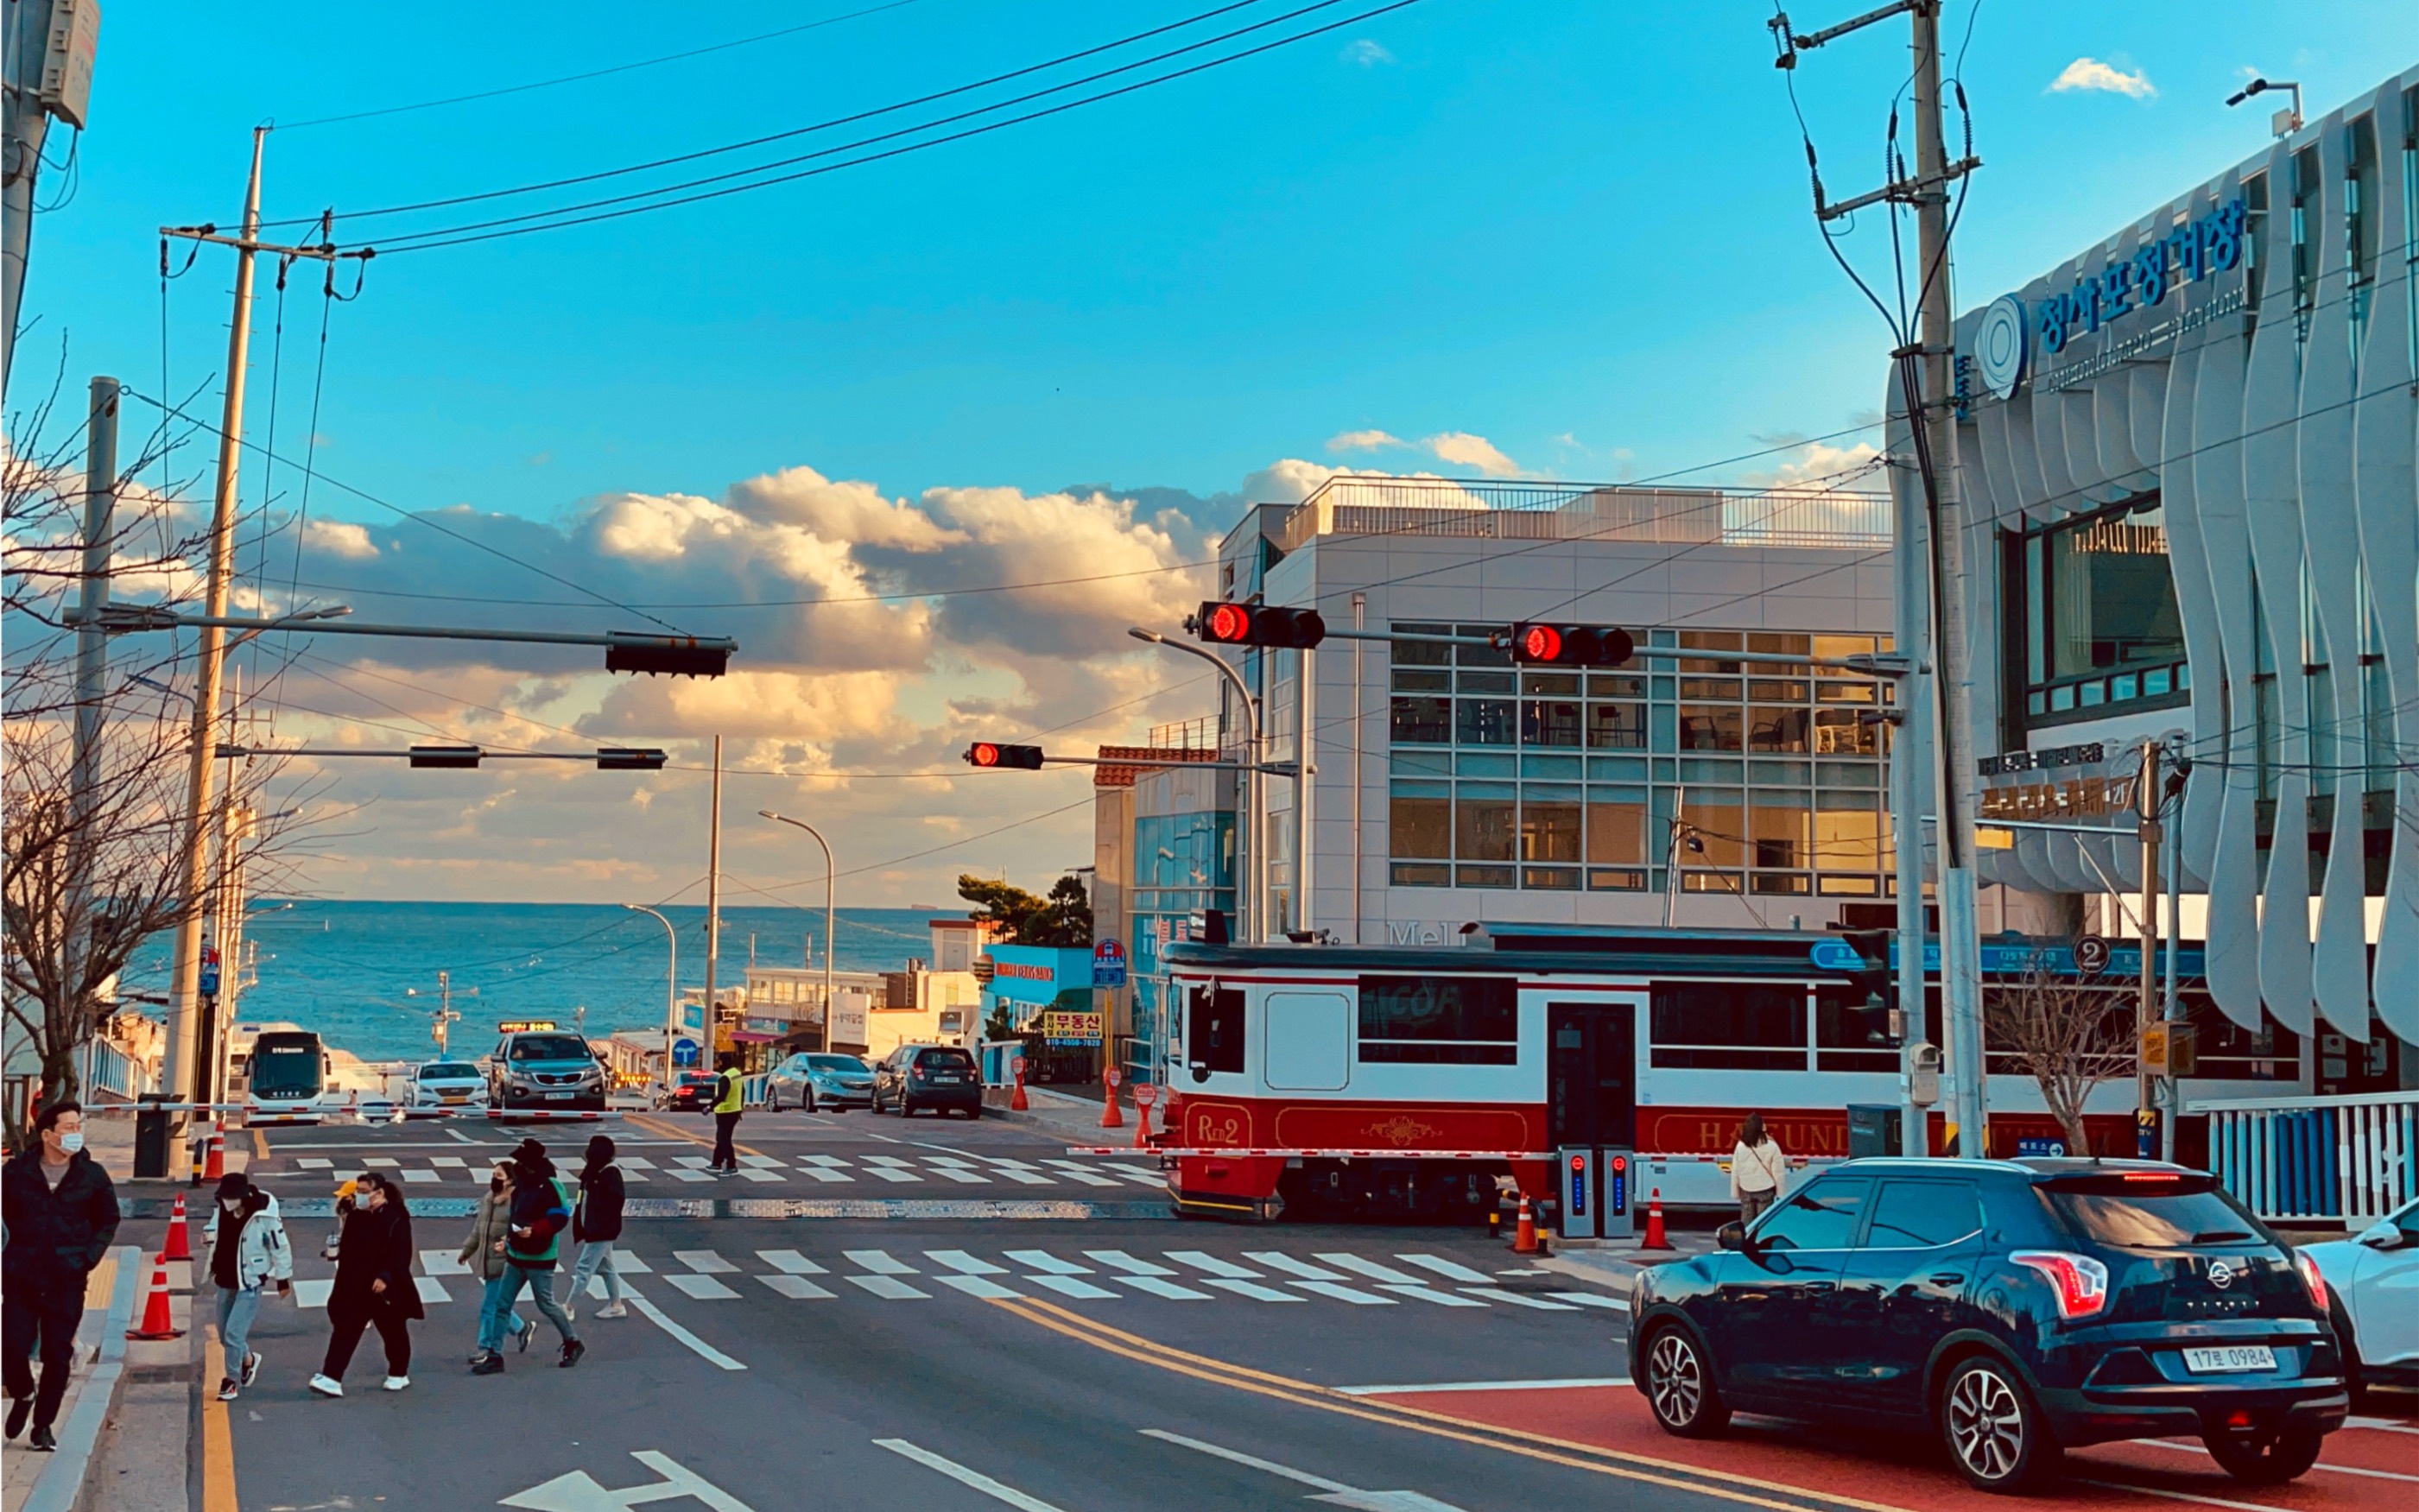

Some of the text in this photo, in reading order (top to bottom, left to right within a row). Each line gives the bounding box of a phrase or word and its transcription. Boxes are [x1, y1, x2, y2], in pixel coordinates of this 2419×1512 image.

[2039, 199, 2245, 354] 청사포정거장
[2082, 941, 2100, 967] 2
[1055, 1014, 1100, 1030] 부동산
[2194, 1348, 2268, 1368] 17로 0984
